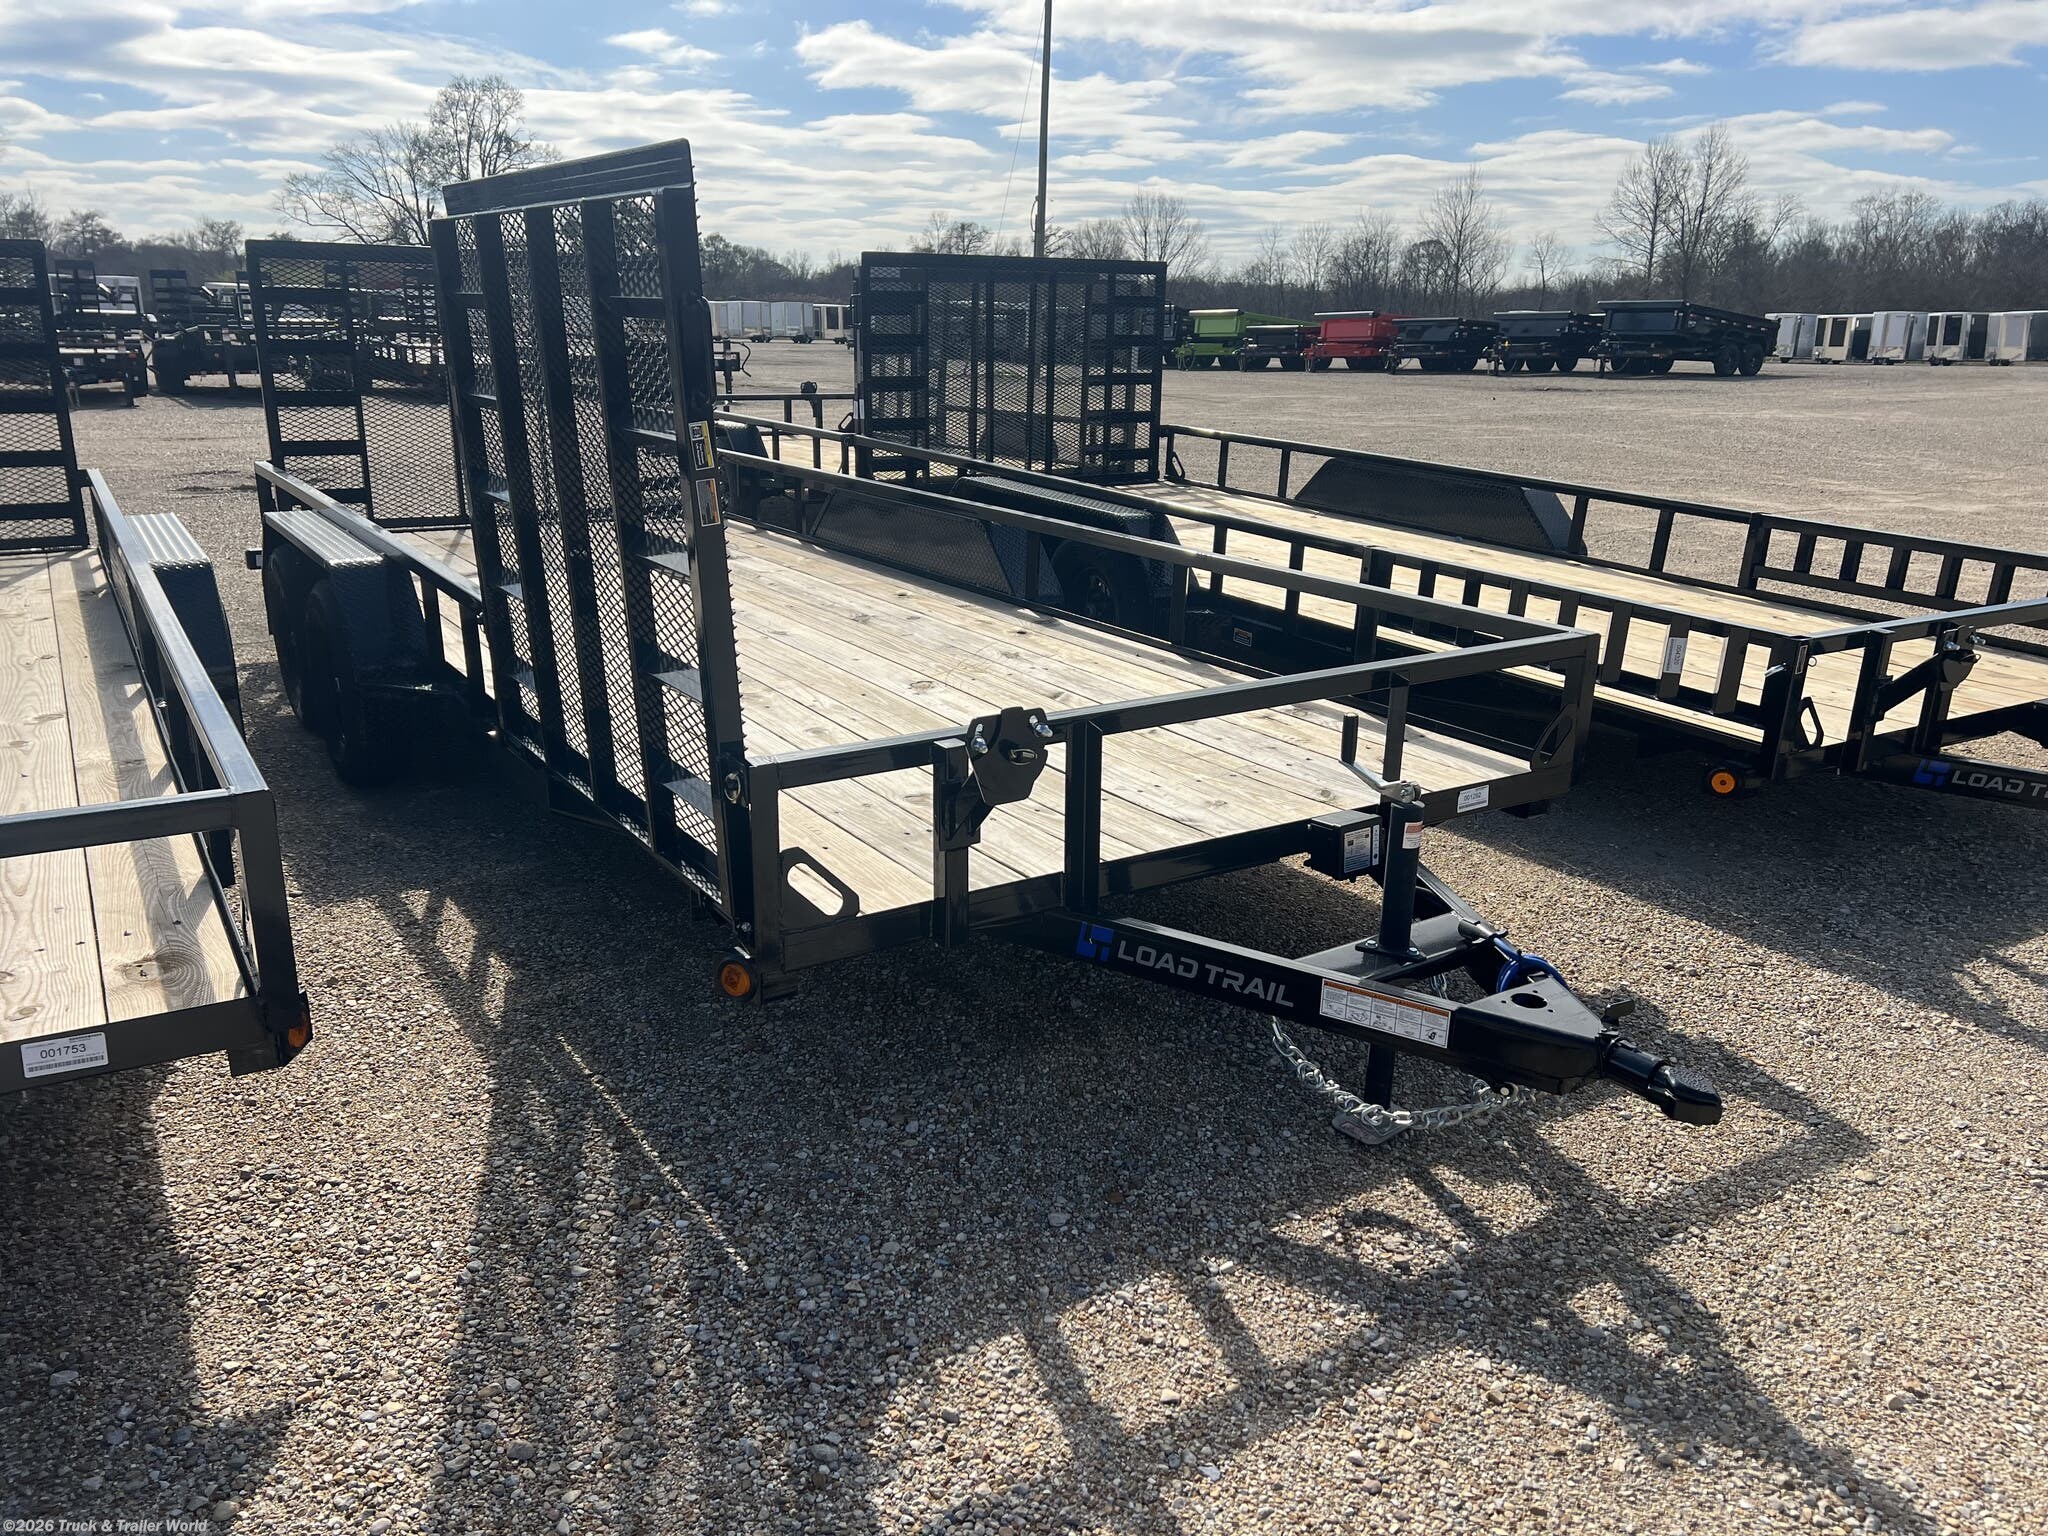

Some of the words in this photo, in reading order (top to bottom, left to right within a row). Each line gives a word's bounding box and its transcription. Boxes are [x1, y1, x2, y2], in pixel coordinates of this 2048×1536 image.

[1951, 770, 2025, 793] LOAD
[2029, 782, 2048, 798] T
[1117, 940, 1199, 979] LOAD
[1205, 963, 1294, 1008] TRAIL
[40, 1044, 87, 1058] 001753
